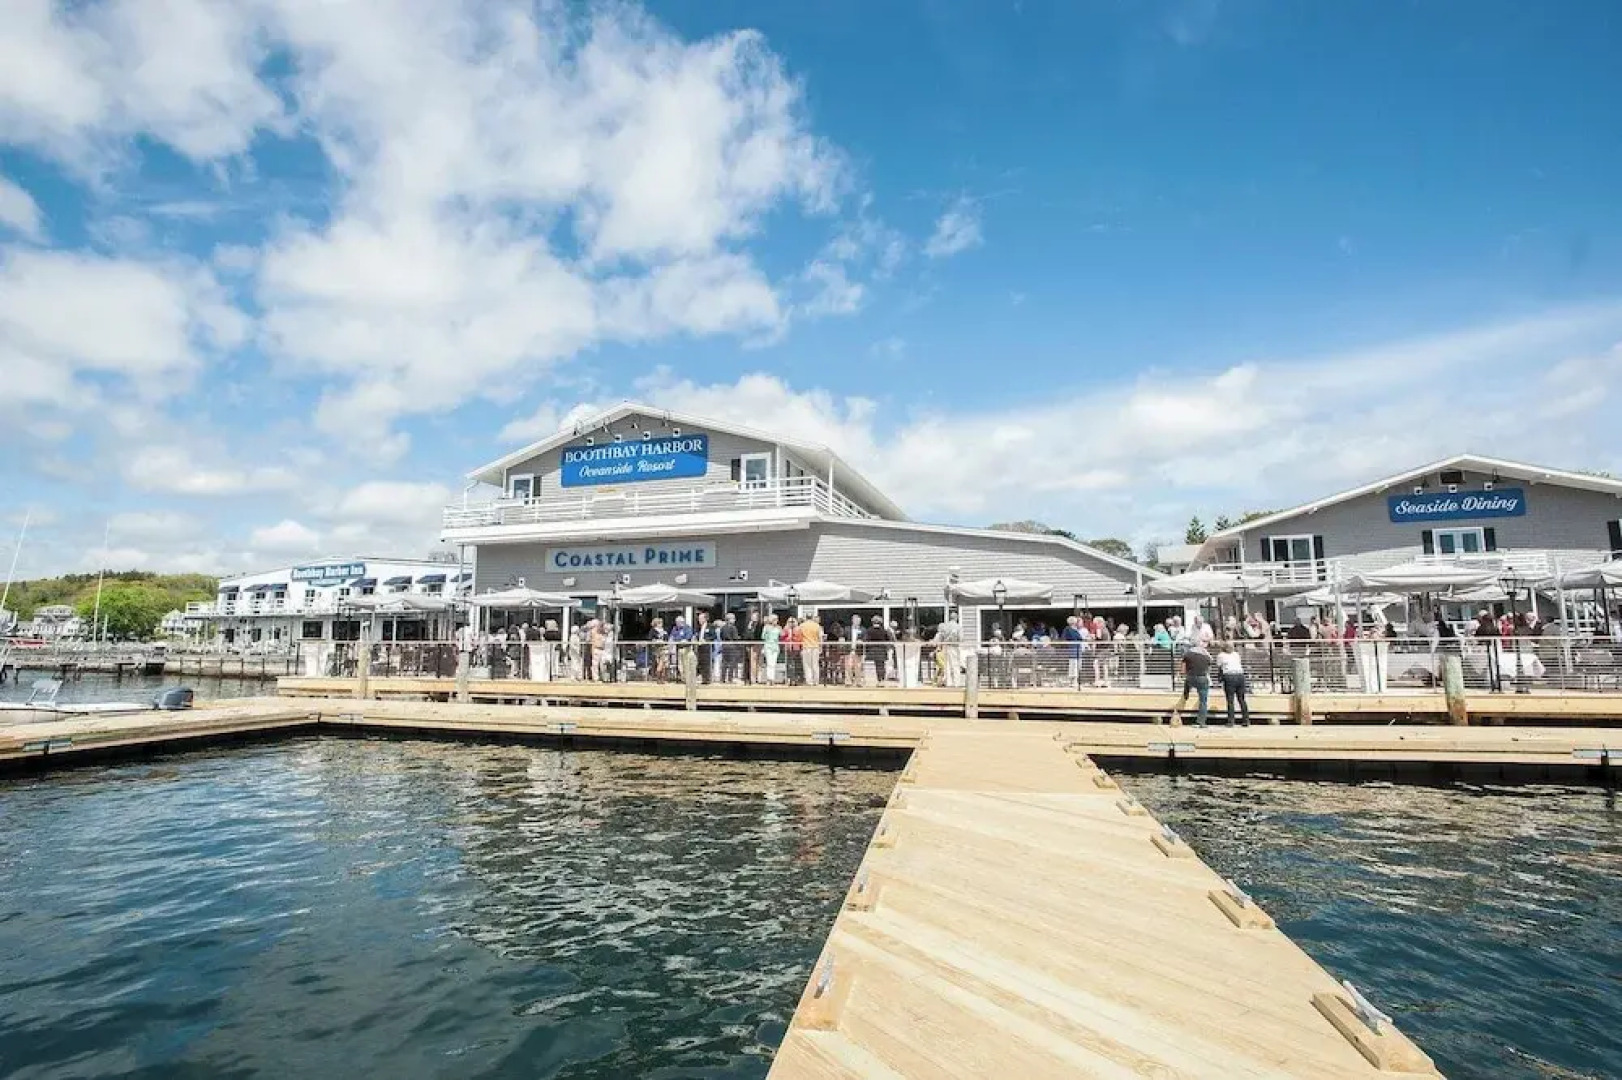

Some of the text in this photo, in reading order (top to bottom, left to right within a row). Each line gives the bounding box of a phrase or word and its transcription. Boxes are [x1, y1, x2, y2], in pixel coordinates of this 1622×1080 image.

[565, 439, 703, 463] BOOTHBAY HARBOR
[578, 458, 676, 478] Oceanside Resort
[1395, 495, 1519, 515] Seaside Dining
[554, 547, 705, 568] COASTAL PRIME
